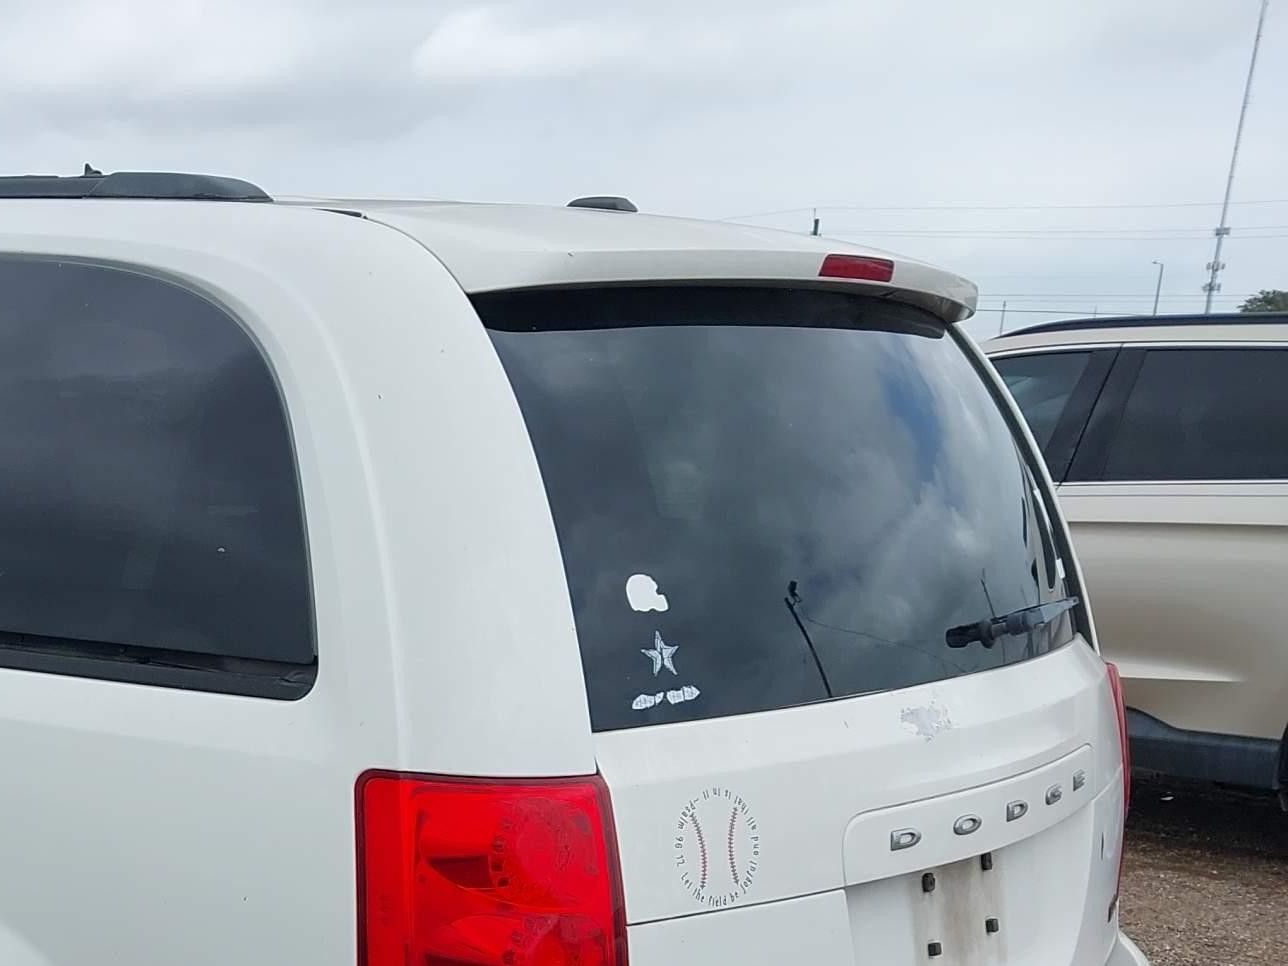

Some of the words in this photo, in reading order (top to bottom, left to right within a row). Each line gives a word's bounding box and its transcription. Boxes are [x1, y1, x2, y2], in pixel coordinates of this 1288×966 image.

[890, 769, 1086, 851] DODGE
[708, 895, 728, 907] field
[729, 891, 740, 903] be
